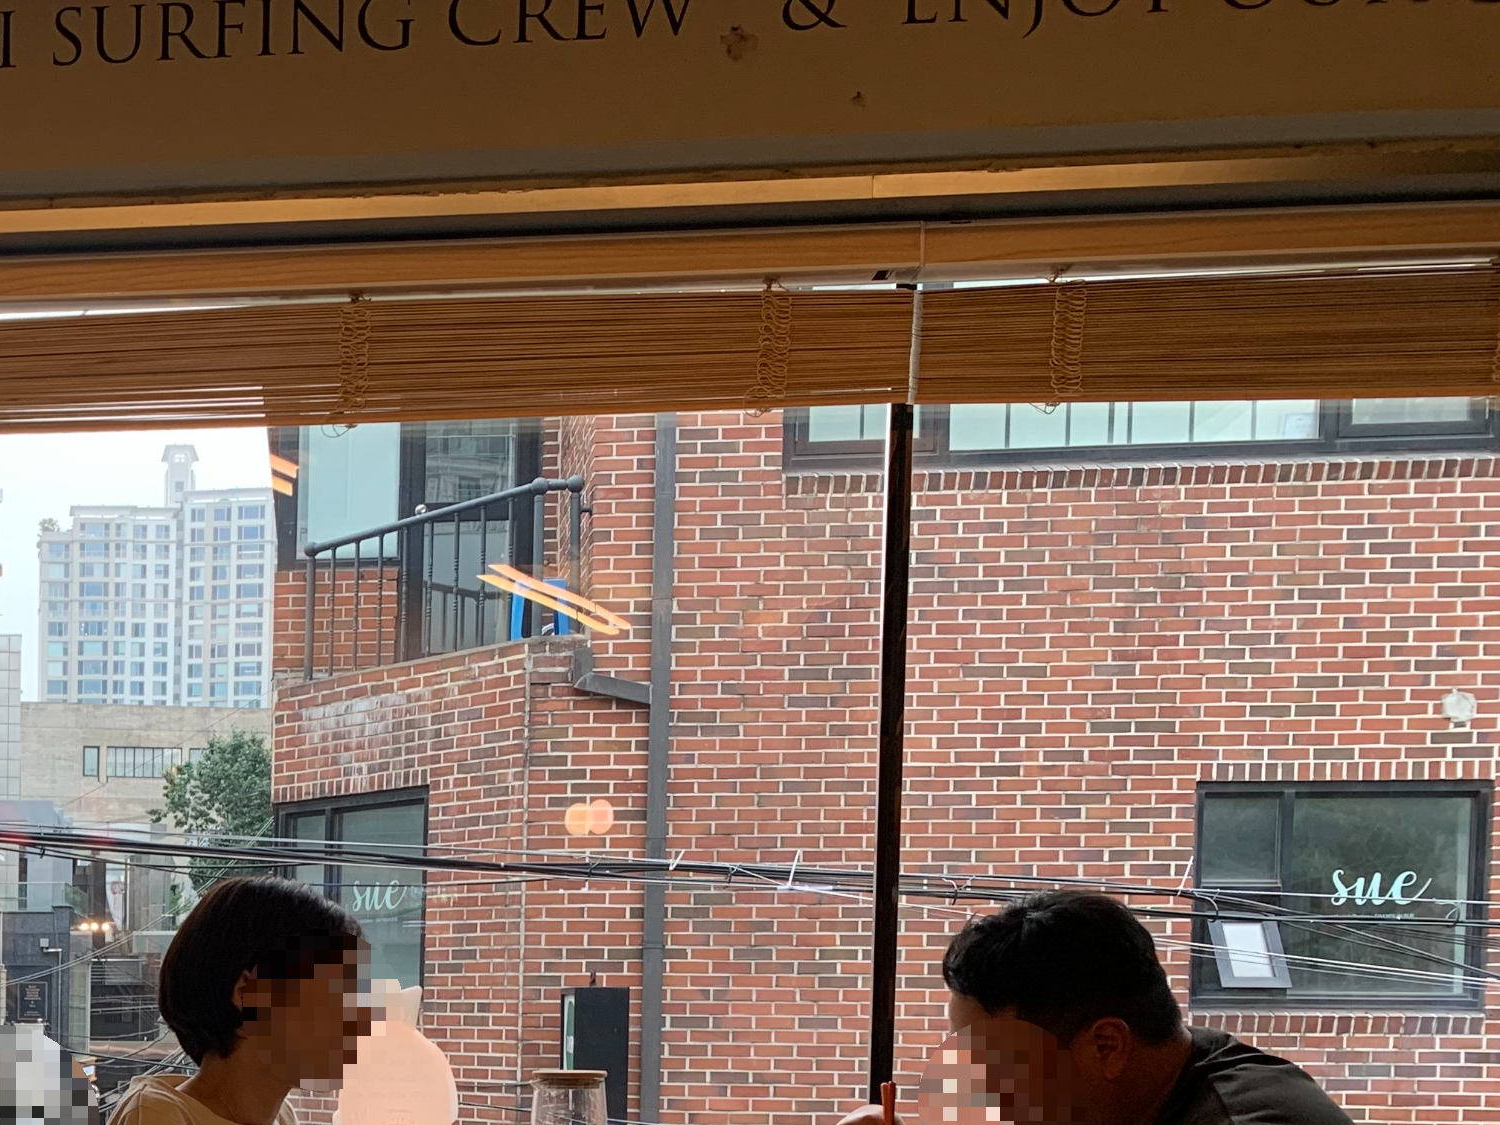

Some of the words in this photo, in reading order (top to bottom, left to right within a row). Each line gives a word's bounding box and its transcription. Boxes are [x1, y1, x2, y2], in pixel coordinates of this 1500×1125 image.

[52, 0, 415, 67] SURFING
[448, 0, 690, 46] CREW
[352, 879, 408, 912] sue
[1331, 869, 1433, 906] sue
